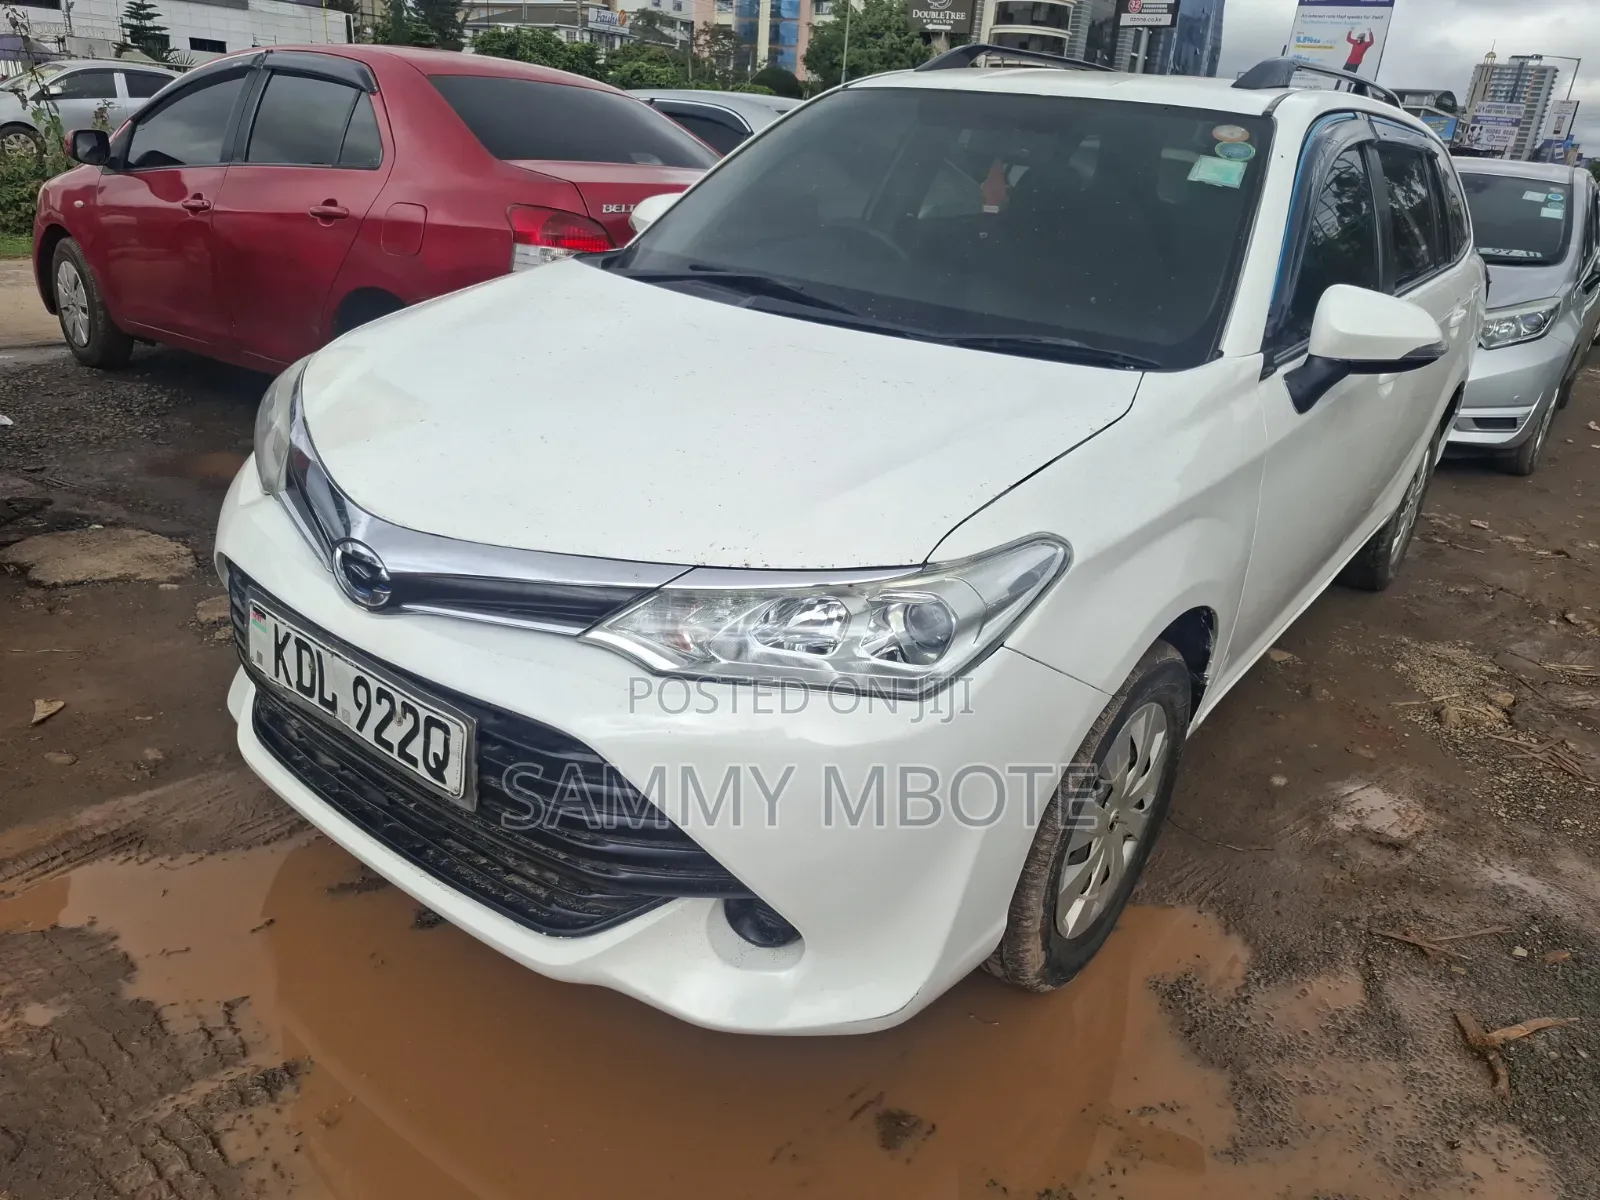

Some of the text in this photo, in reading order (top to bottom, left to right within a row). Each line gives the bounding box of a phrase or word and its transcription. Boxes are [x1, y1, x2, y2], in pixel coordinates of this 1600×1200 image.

[1130, 0, 1141, 8] 32
[602, 204, 637, 213] BELT
[274, 623, 452, 784] KDL 922Q
